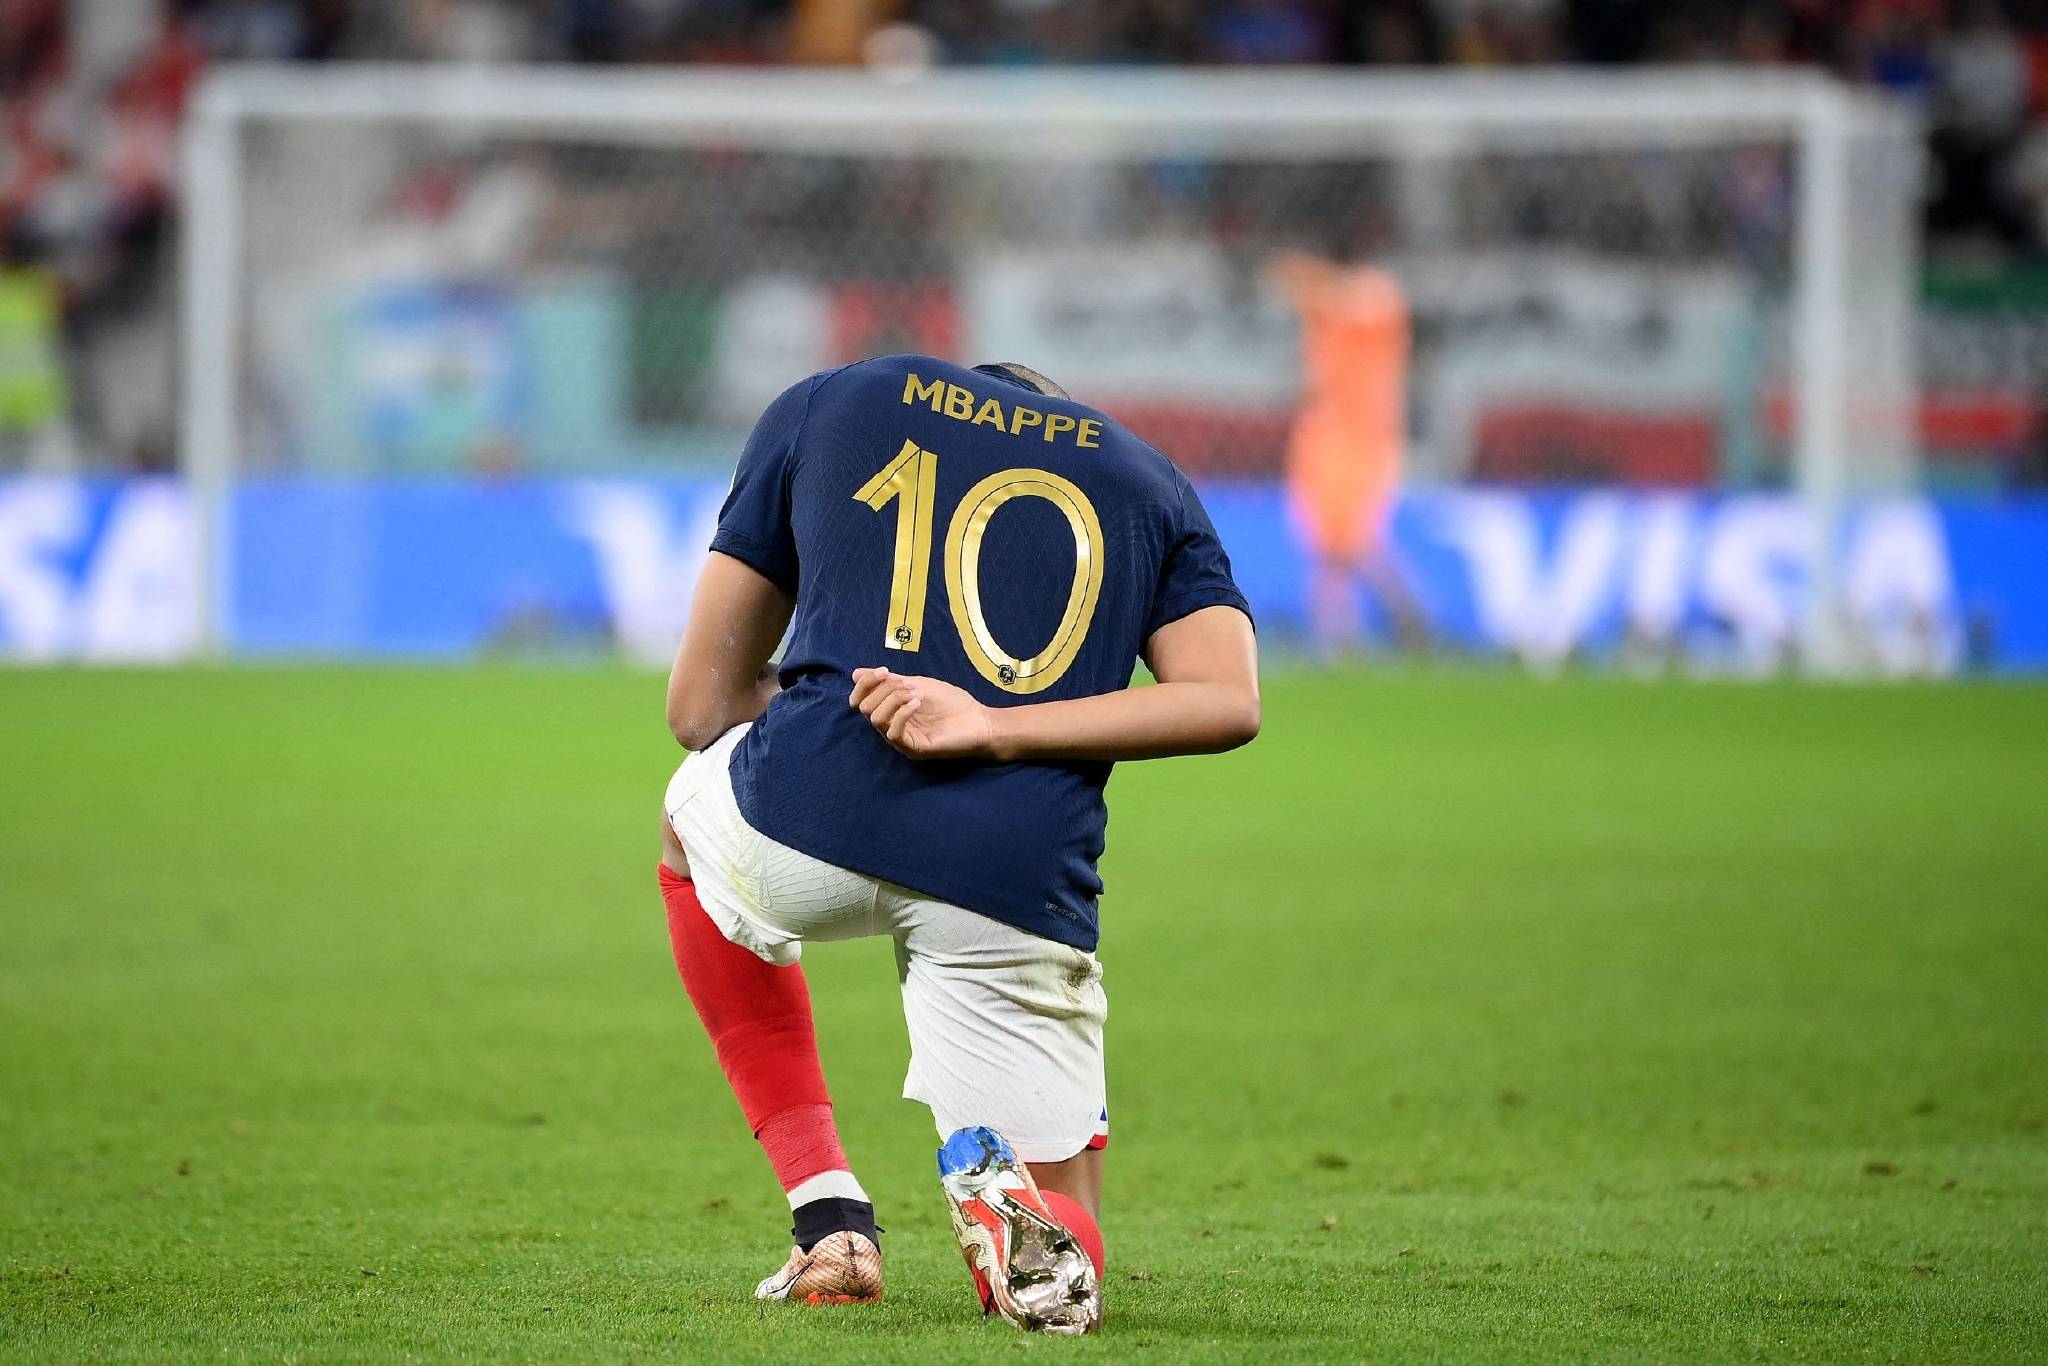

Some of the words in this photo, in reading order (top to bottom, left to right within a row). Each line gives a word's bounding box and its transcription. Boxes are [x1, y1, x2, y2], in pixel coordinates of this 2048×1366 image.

[902, 373, 1103, 449] MBAPPE
[0, 478, 203, 658] SA
[852, 438, 1104, 694] 10
[1442, 492, 1962, 670] VISA
